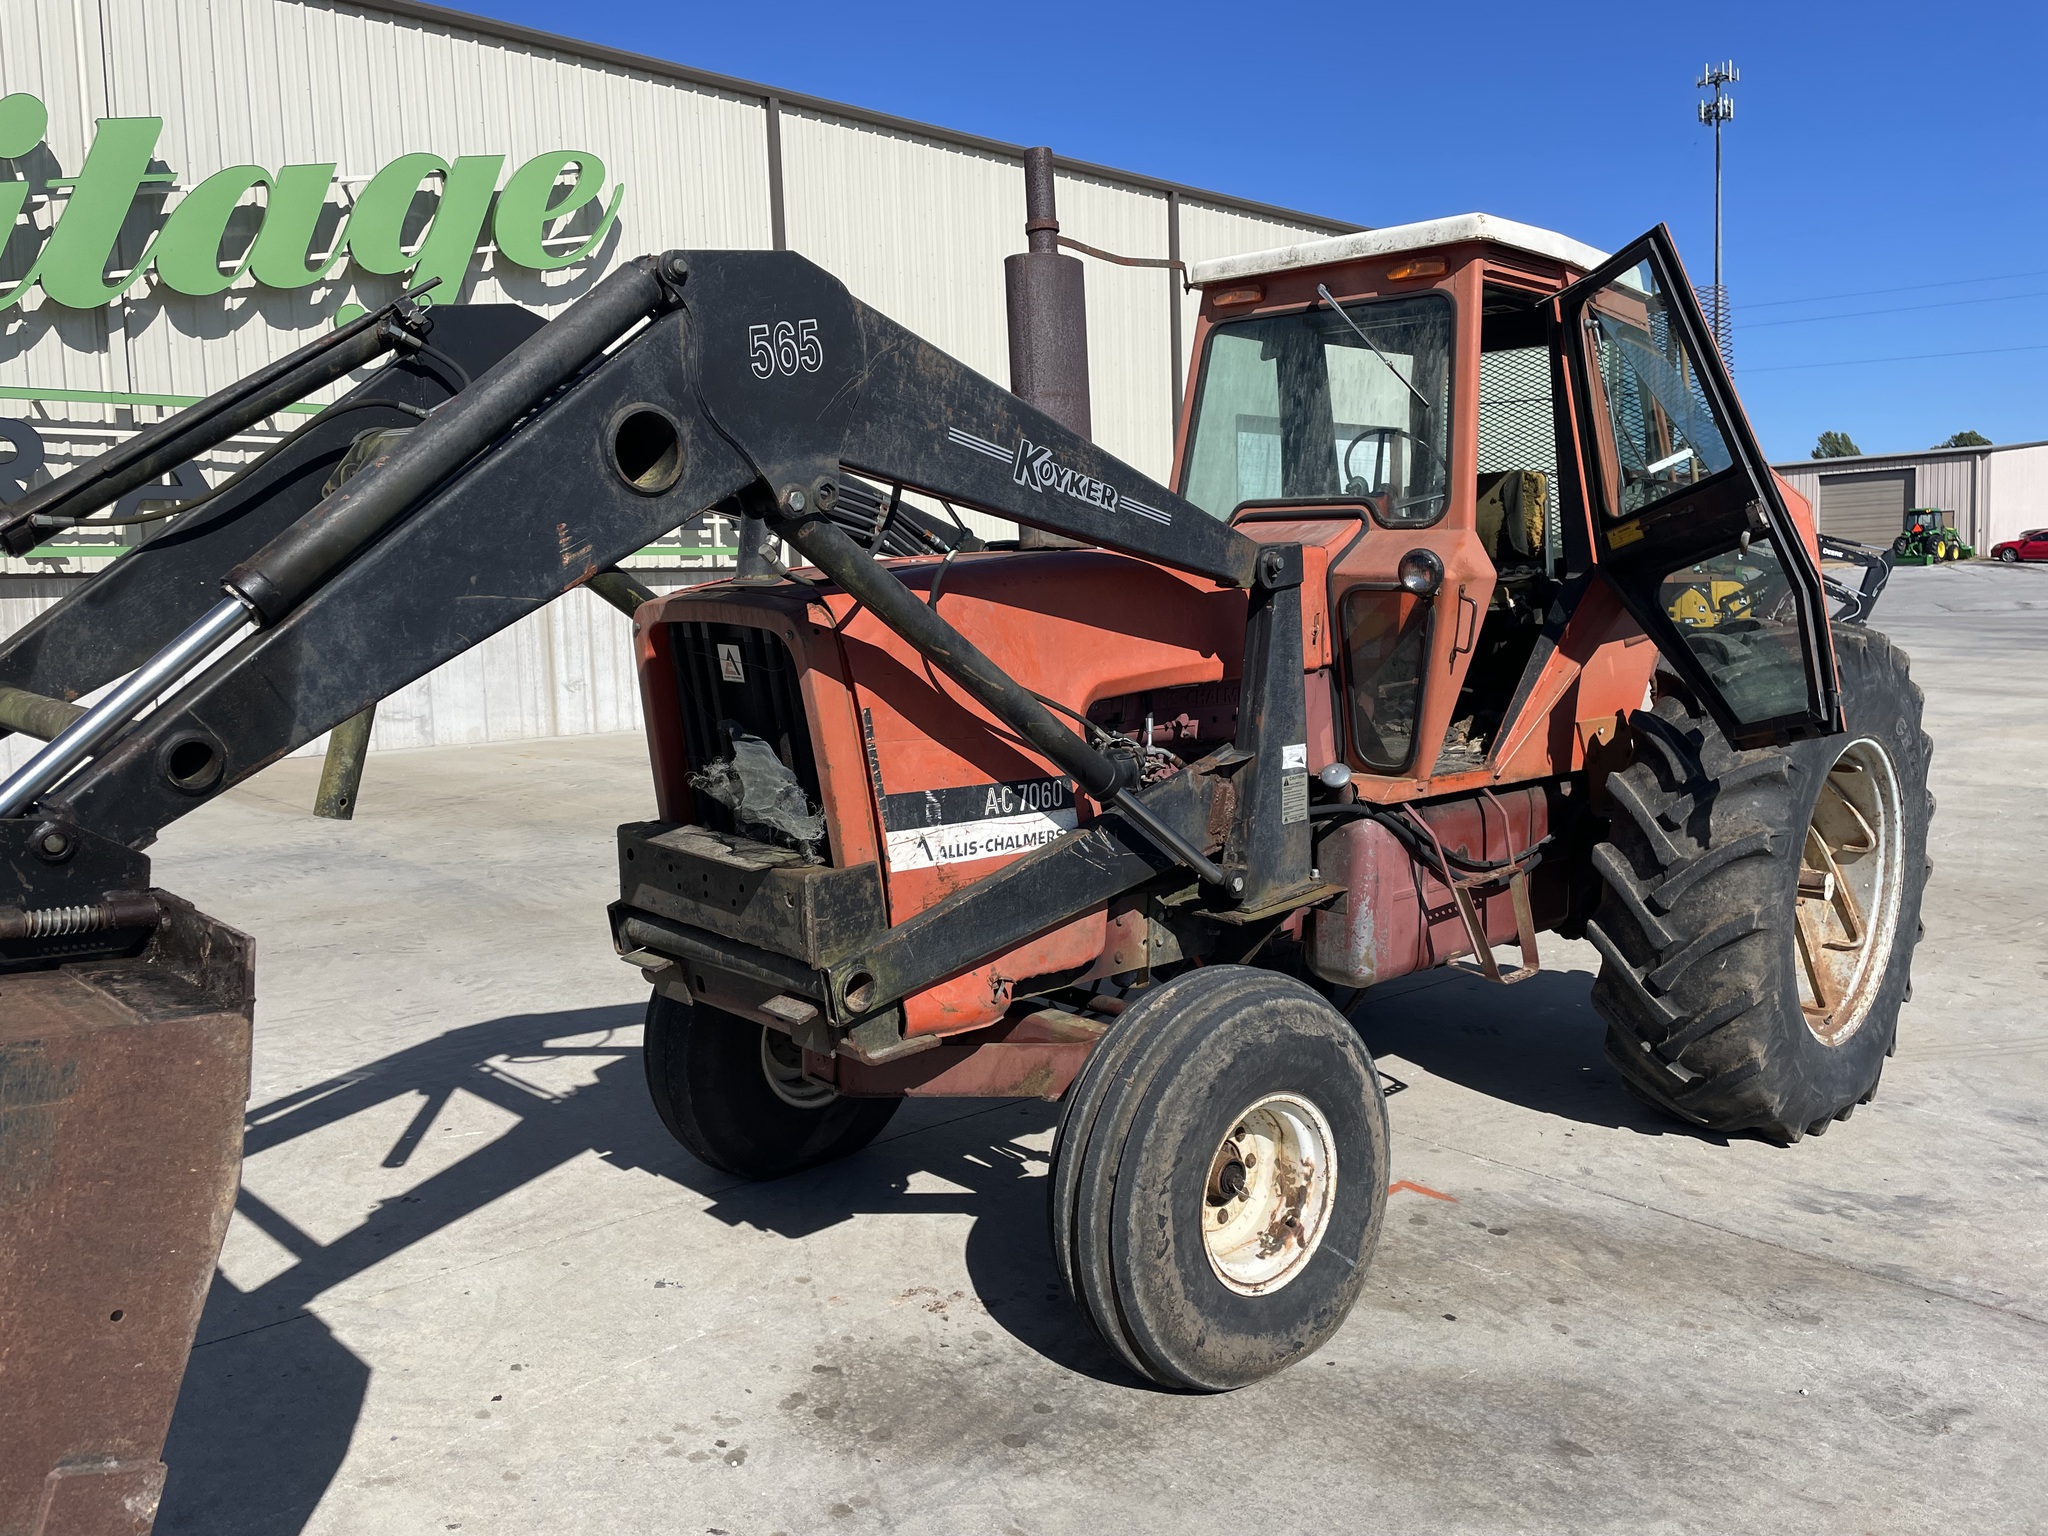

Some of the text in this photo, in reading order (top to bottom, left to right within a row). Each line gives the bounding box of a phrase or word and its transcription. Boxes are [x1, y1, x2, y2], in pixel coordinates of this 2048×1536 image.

[749, 319, 823, 379] 565
[1013, 438, 1118, 513] KOYKER
[1822, 547, 1845, 558] DEERE
[984, 779, 1063, 816] A-C 7060
[938, 828, 1064, 860] ALLIS-CHALMERS
